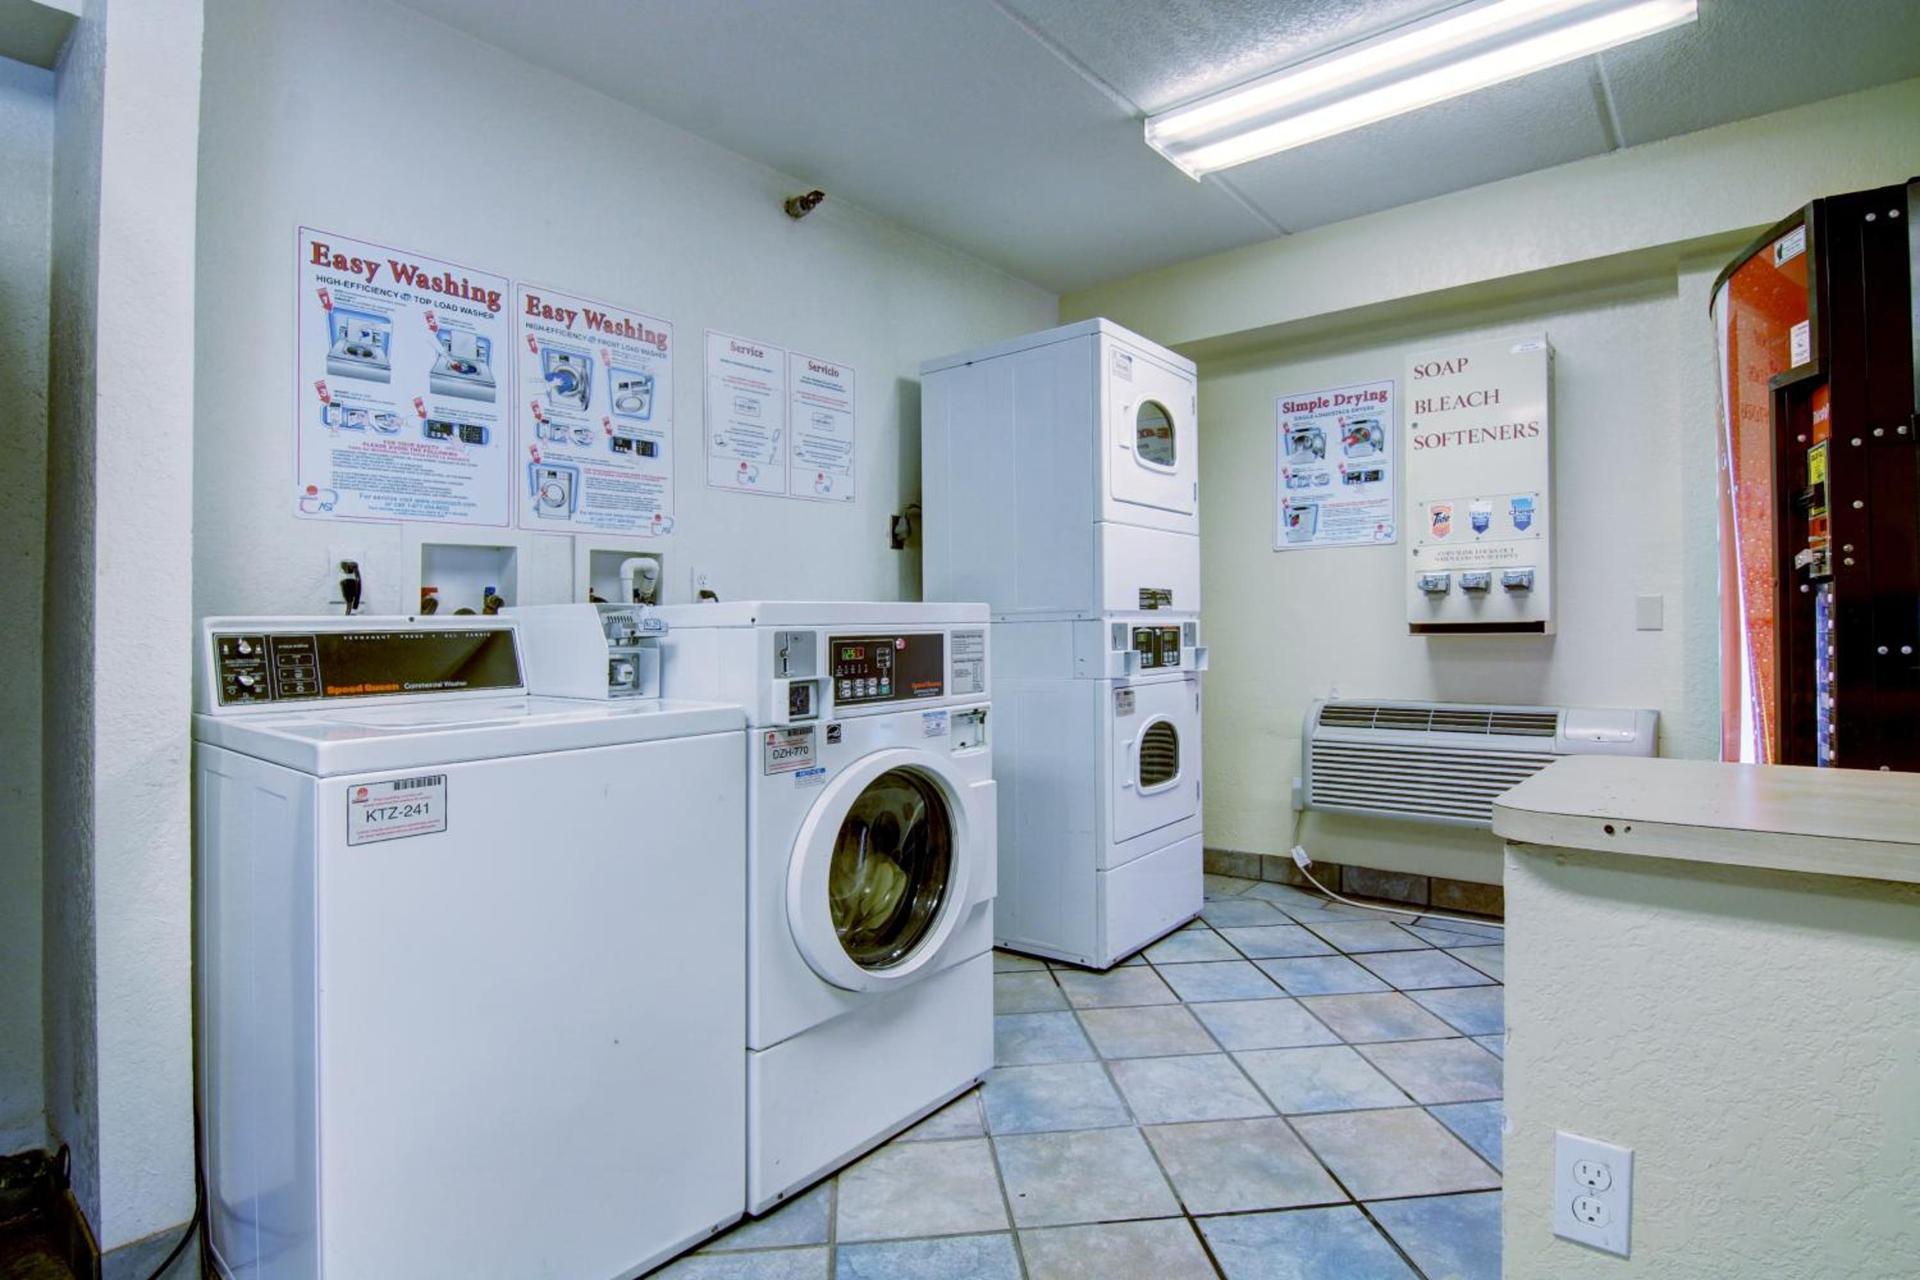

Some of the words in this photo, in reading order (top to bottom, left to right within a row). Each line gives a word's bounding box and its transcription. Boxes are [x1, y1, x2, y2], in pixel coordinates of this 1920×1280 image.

[310, 241, 381, 283] Easy
[388, 259, 502, 312] Washing
[315, 274, 399, 299] HIGH-EFFICIENCY
[414, 296, 432, 305] TOP
[434, 300, 458, 312] LOAD
[460, 306, 495, 320] WASHER
[525, 294, 578, 330] Easy
[582, 308, 667, 351] Washing
[526, 321, 587, 342] HIGH-EFFICIENCY
[730, 341, 764, 358] Service
[808, 360, 839, 378] Servicio
[1413, 358, 1468, 380] SOAP
[1282, 396, 1330, 414] Simple
[1334, 390, 1388, 406] Drying
[1414, 389, 1500, 415] BLEACH
[1413, 421, 1539, 450] SOFTENERS
[773, 746, 809, 760] DZH-770
[366, 803, 429, 823] KTZ-241
